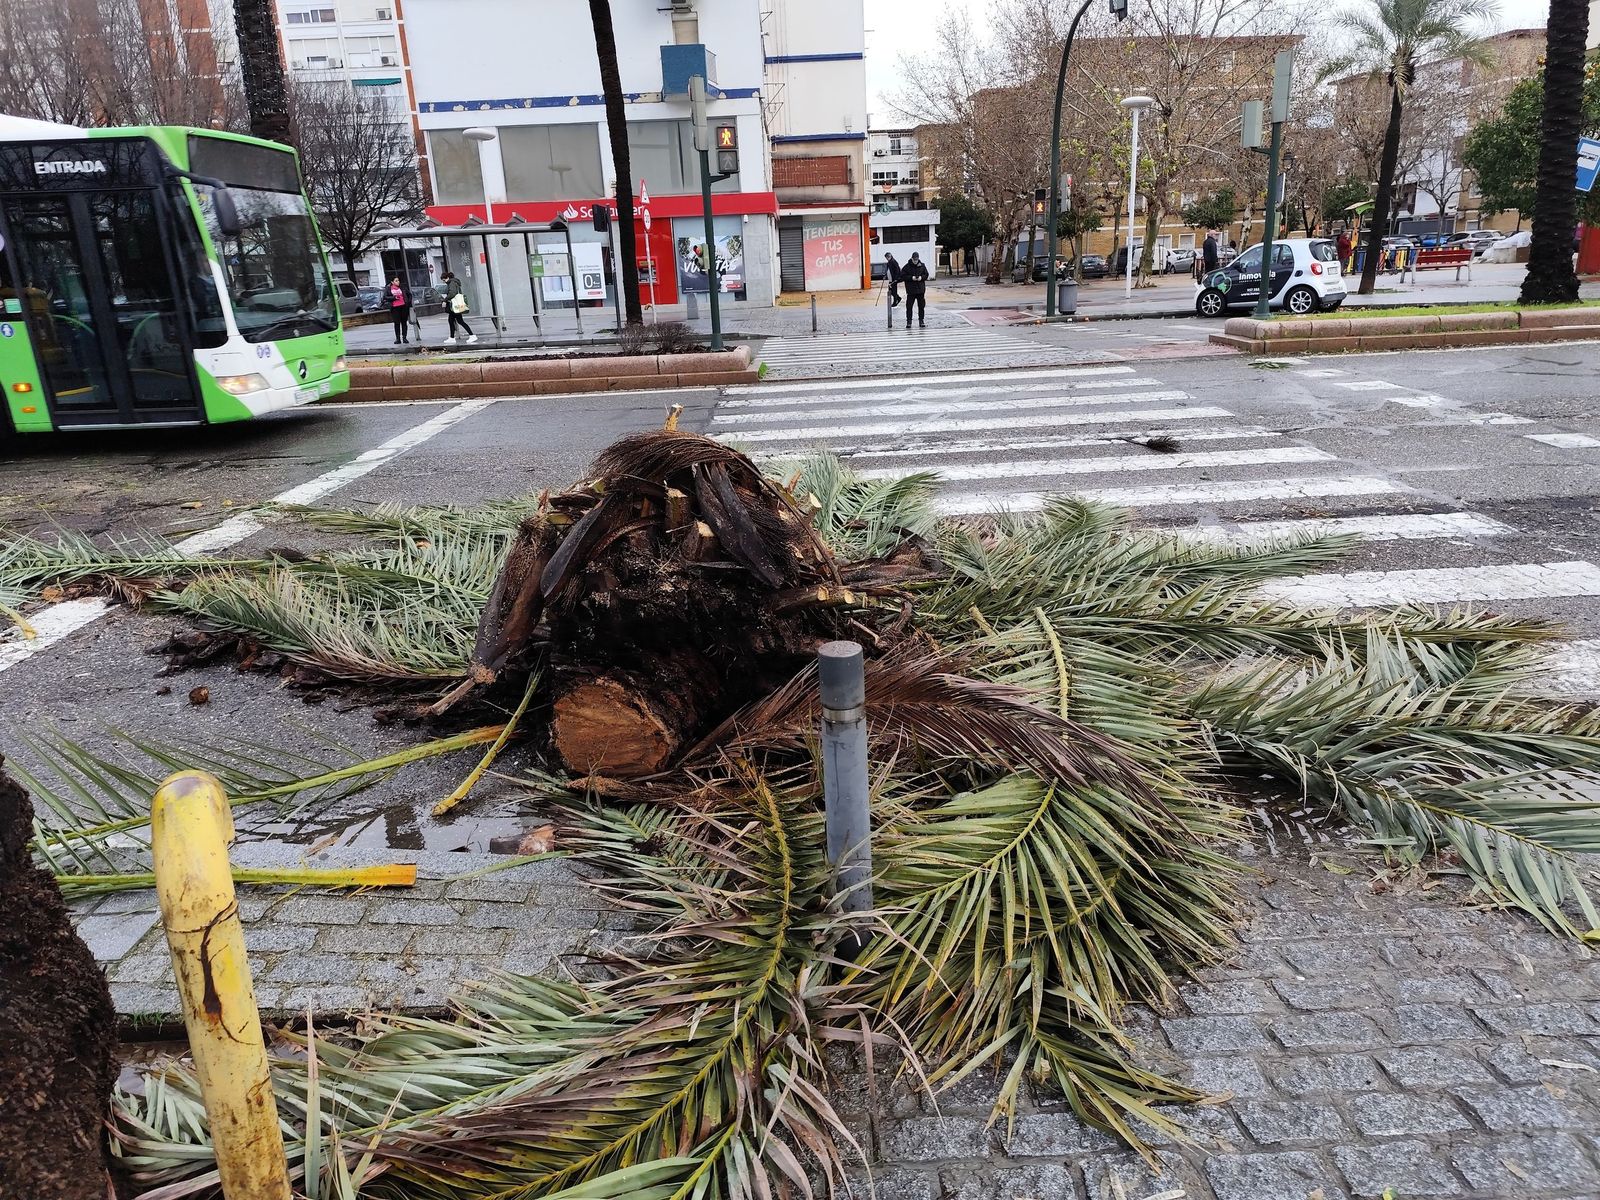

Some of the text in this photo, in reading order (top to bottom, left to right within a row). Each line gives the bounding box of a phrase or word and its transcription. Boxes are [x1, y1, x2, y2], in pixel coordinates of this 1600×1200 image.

[34, 160, 106, 174] ENTRADA
[803, 223, 857, 240] TENEMOS
[822, 240, 843, 252] TUS
[815, 252, 854, 268] GAFAS
